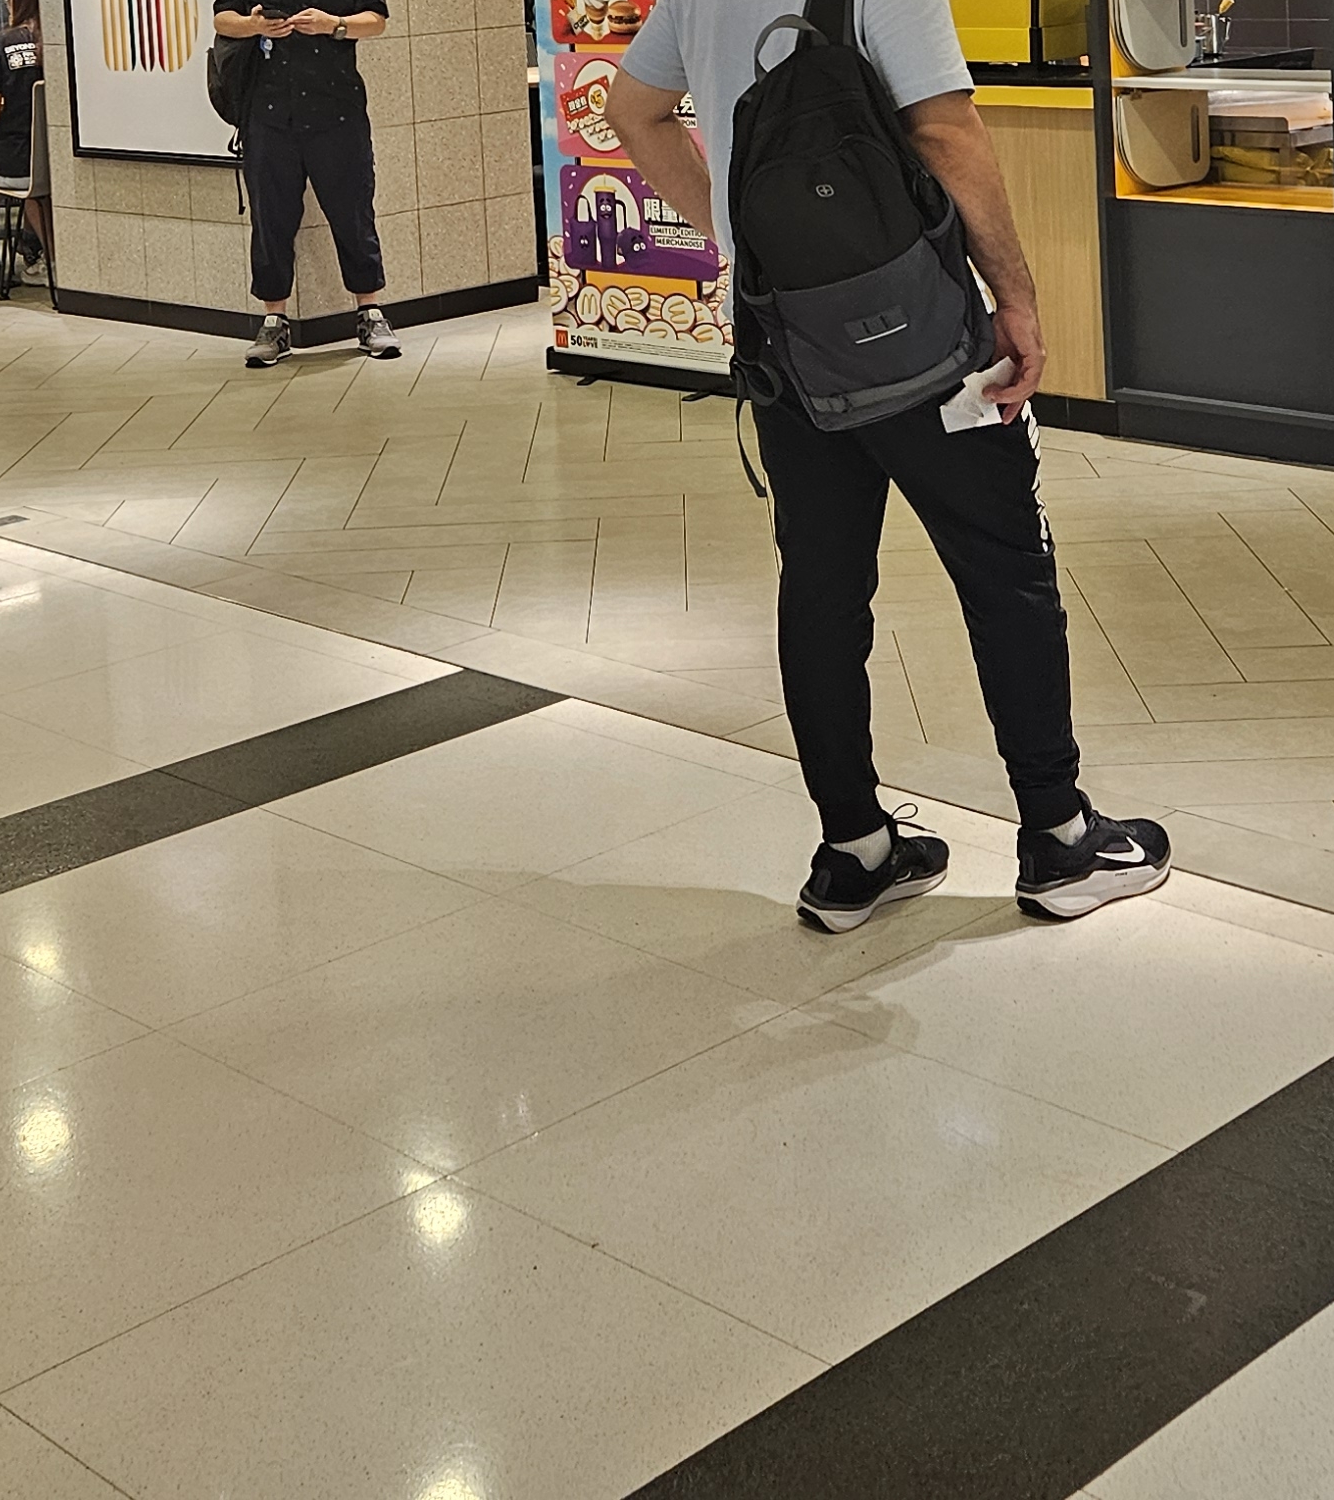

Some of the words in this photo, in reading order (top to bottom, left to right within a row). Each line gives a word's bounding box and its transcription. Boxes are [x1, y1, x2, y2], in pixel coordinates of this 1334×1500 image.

[650, 226, 677, 236] LIMITED
[656, 238, 703, 249] MERCHANDISE
[571, 335, 582, 346] 50
